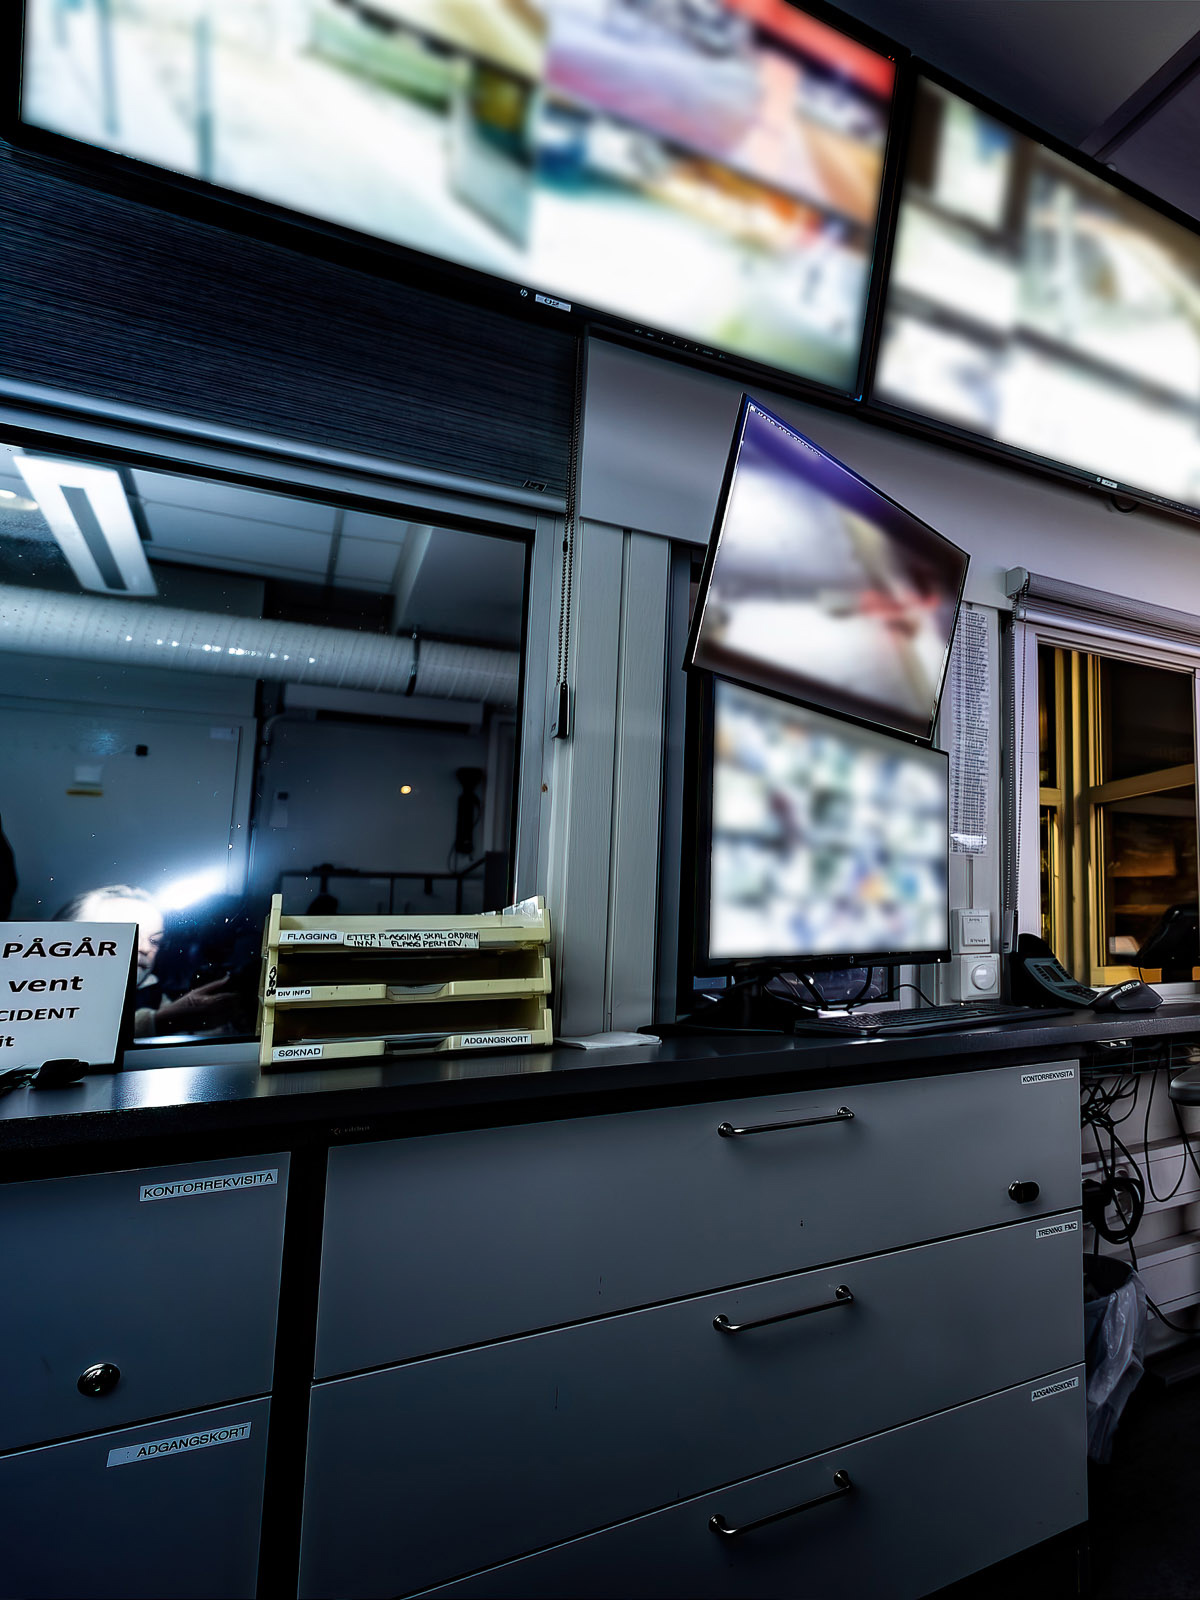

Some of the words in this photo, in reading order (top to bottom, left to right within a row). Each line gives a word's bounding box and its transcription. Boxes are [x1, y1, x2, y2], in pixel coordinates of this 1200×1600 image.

[287, 932, 338, 941] FLAGGING
[346, 933, 377, 941] ETTER
[379, 932, 421, 941] FLAGGING
[423, 932, 446, 940] SKAL
[447, 931, 479, 940] ORDREN
[2, 936, 118, 958] PÅGÅR
[8, 976, 84, 993] vent
[463, 1034, 529, 1045] ADGANGSKORT
[278, 1047, 321, 1058] SØKNAD
[143, 1171, 274, 1199] KONTORREKVISITA
[136, 1425, 249, 1458] ADGANGSKORT
